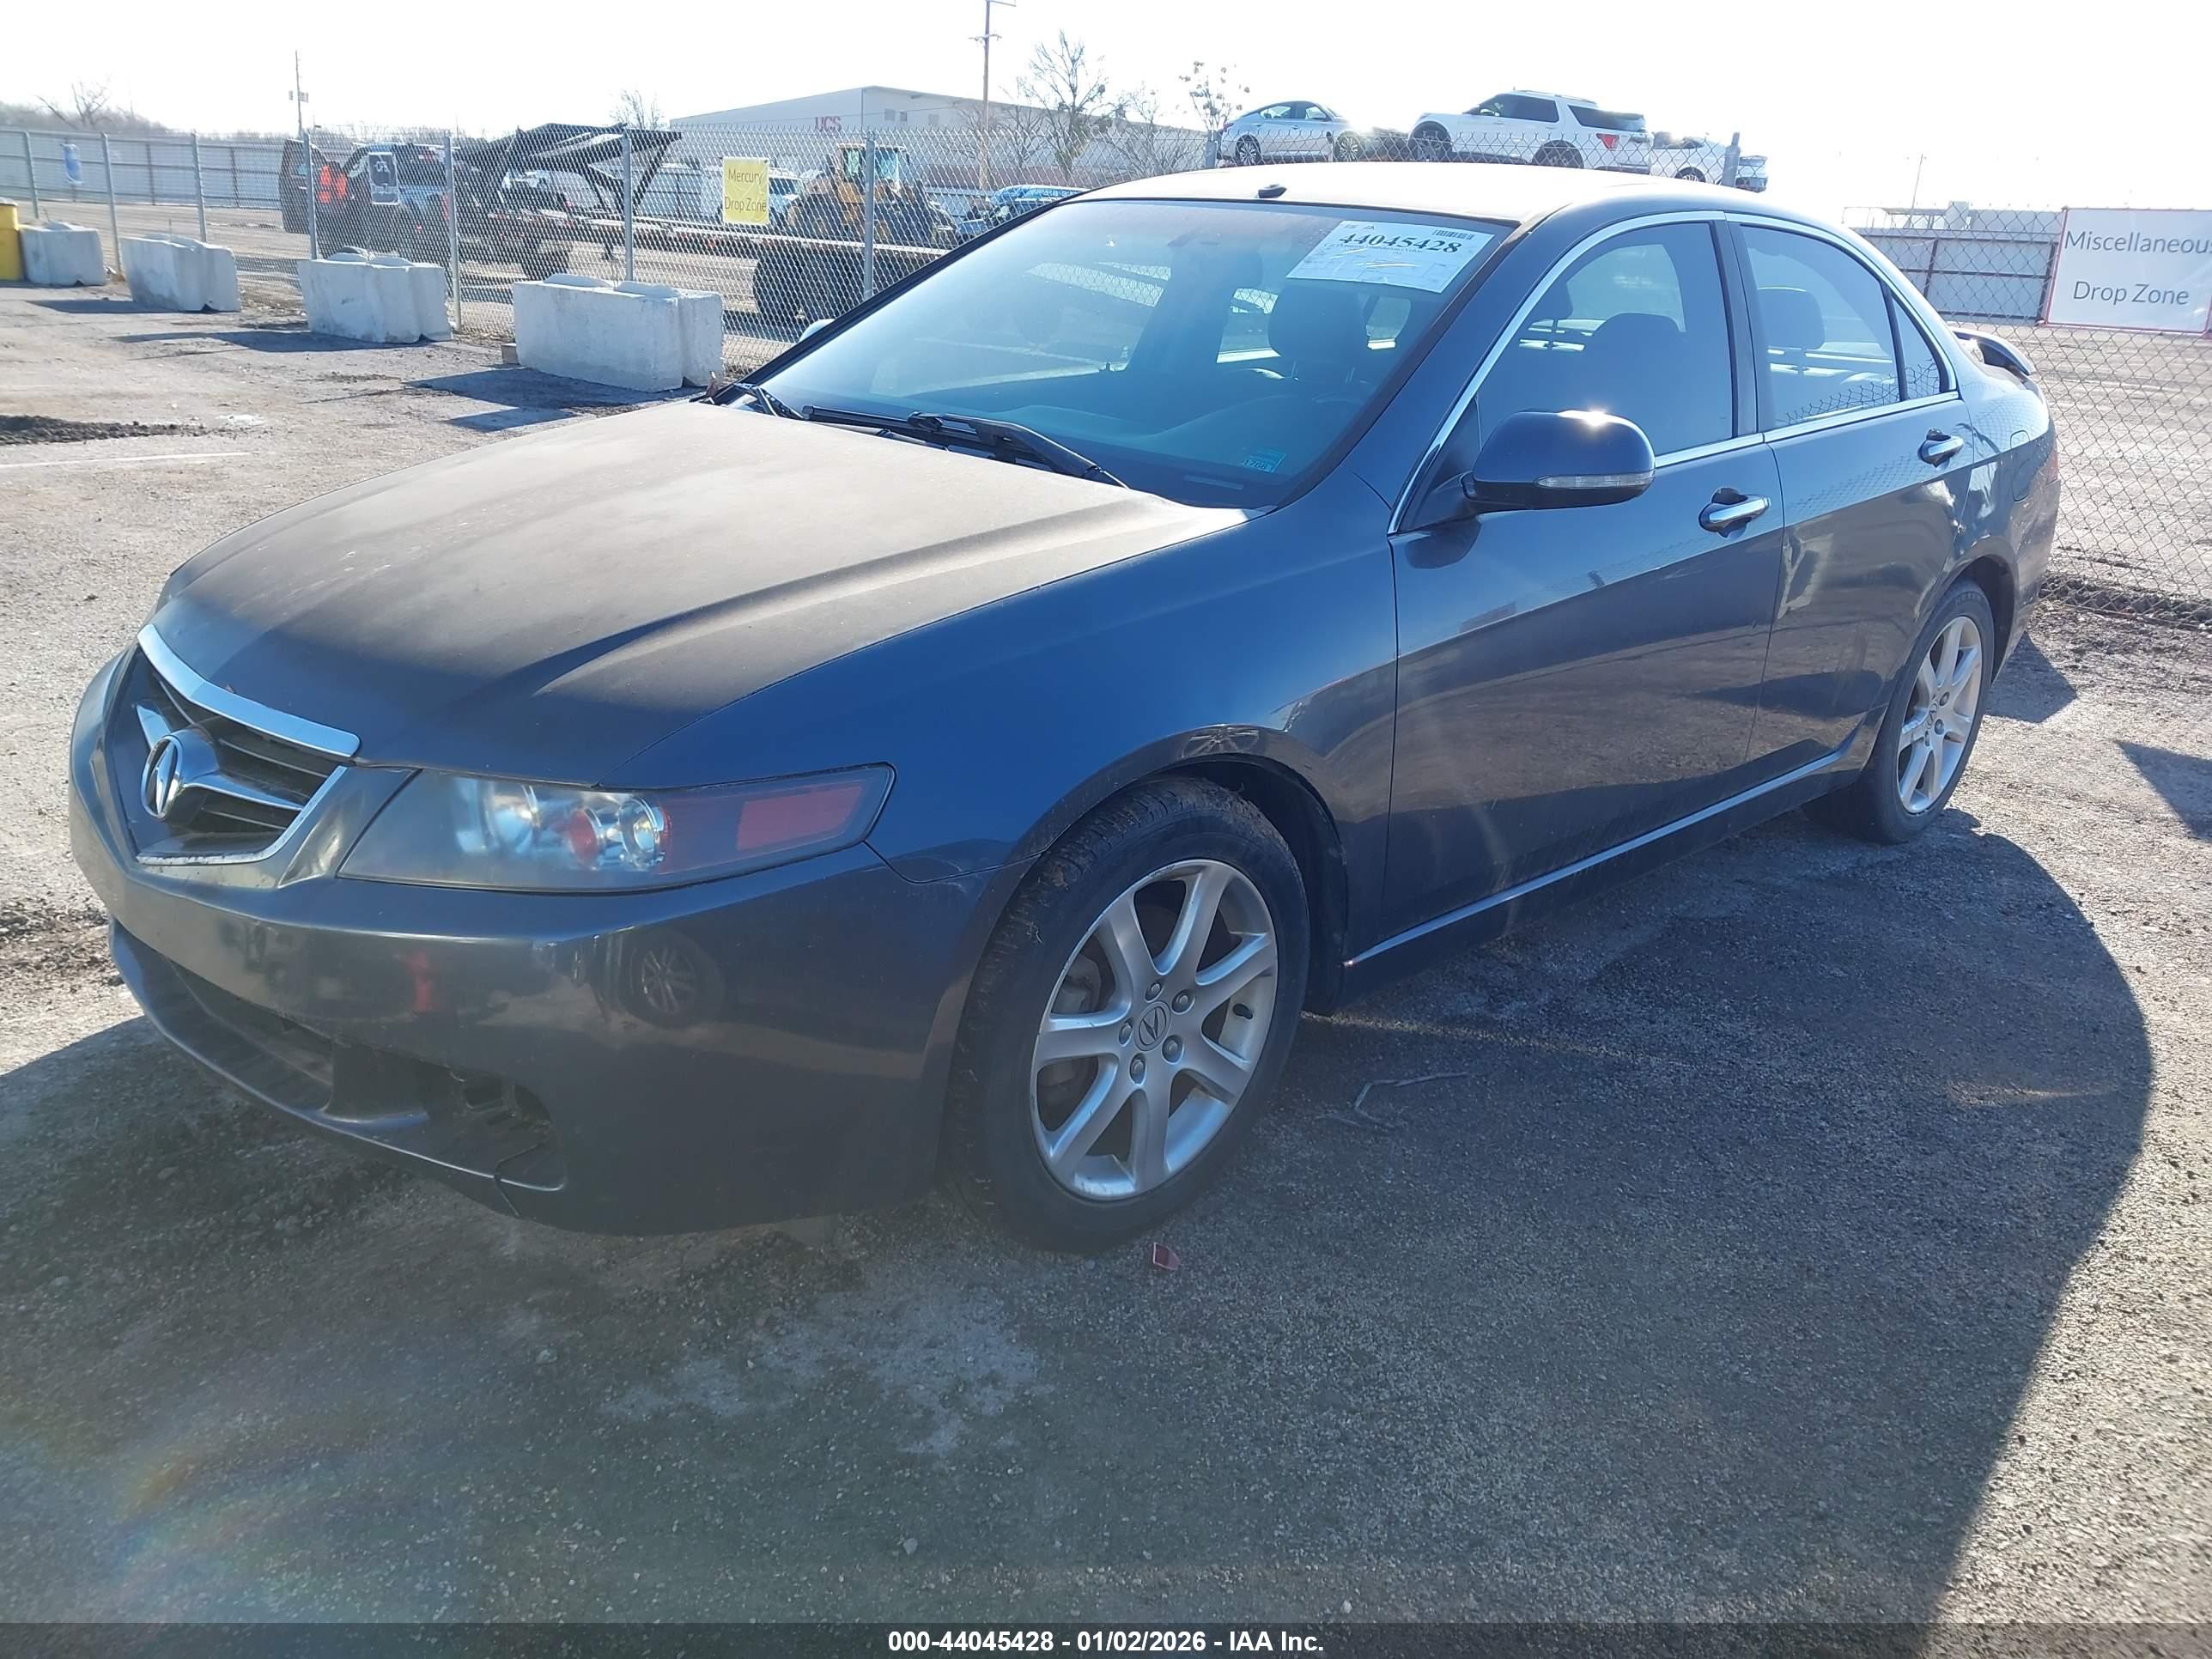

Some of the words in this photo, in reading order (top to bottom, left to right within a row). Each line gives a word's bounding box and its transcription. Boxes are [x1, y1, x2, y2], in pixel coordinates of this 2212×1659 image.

[815, 116, 842, 131] UCS
[728, 168, 763, 185] Mercury
[724, 196, 745, 213] Drop
[745, 198, 767, 212] Zone
[1339, 233, 1462, 253] 44045428
[2073, 281, 2127, 306] Drop
[2132, 283, 2190, 305] Zone
